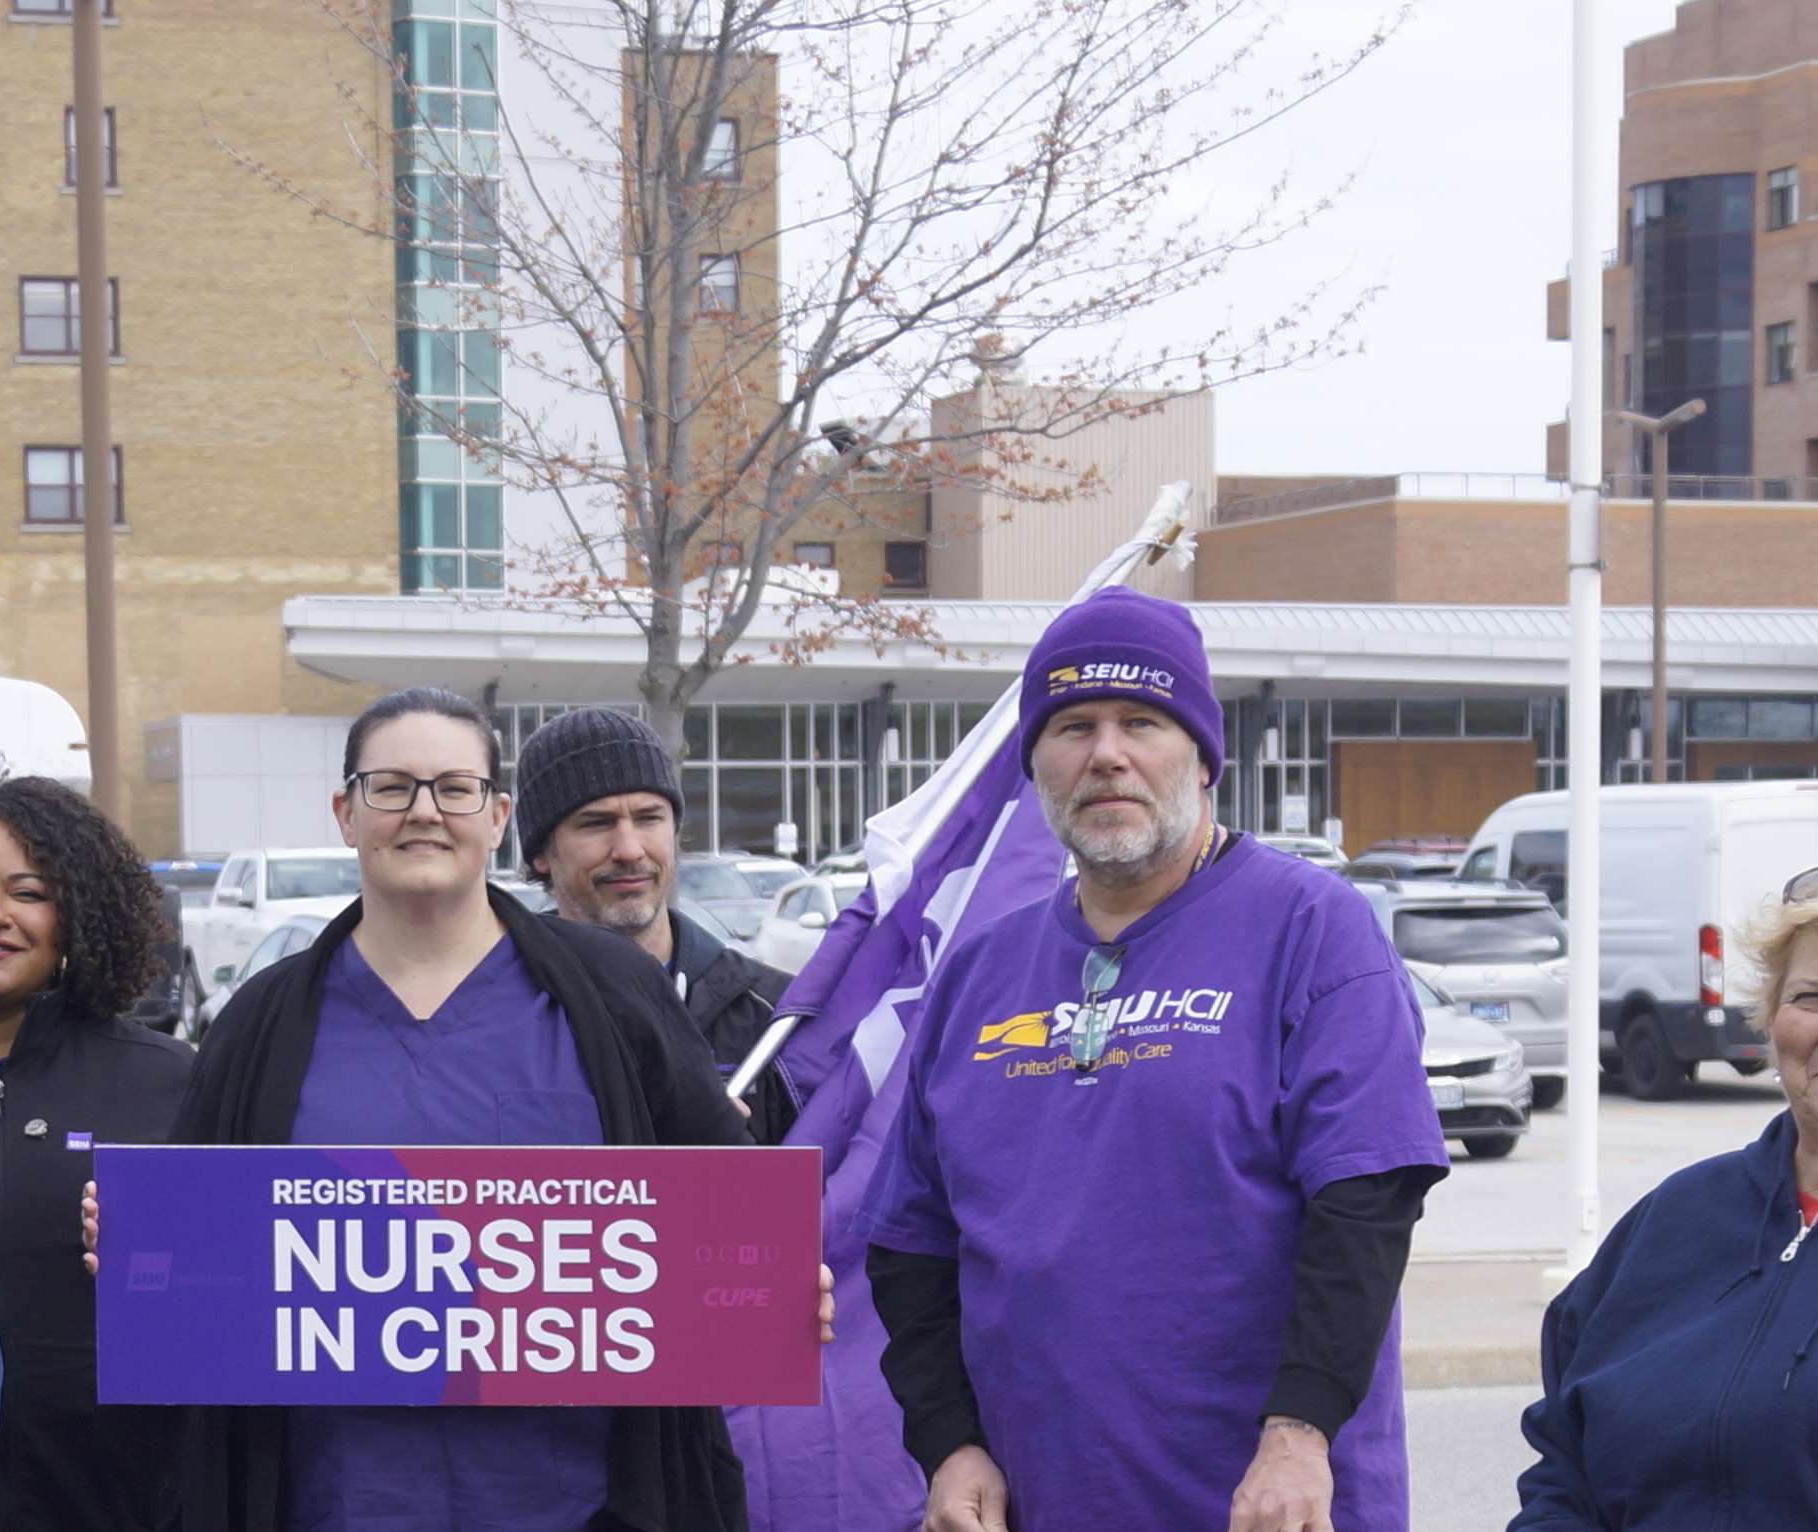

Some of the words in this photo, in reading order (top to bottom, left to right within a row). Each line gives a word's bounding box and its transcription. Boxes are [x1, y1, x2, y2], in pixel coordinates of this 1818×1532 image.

[1079, 663, 1140, 680] SEIU
[1155, 988, 1233, 1021] HCII
[1128, 1022, 1170, 1037] Missouri
[1182, 1020, 1222, 1035] Kansas
[1004, 1056, 1057, 1079] United
[1058, 1053, 1077, 1071] for
[1133, 1042, 1173, 1061] Care
[272, 1177, 469, 1206] REGISTERED
[475, 1178, 658, 1206] PRACTICAL
[273, 1217, 659, 1295] NURSES
[702, 1287, 773, 1307] CUPE
[275, 1306, 356, 1373] IN
[380, 1305, 656, 1374] CRISIS
